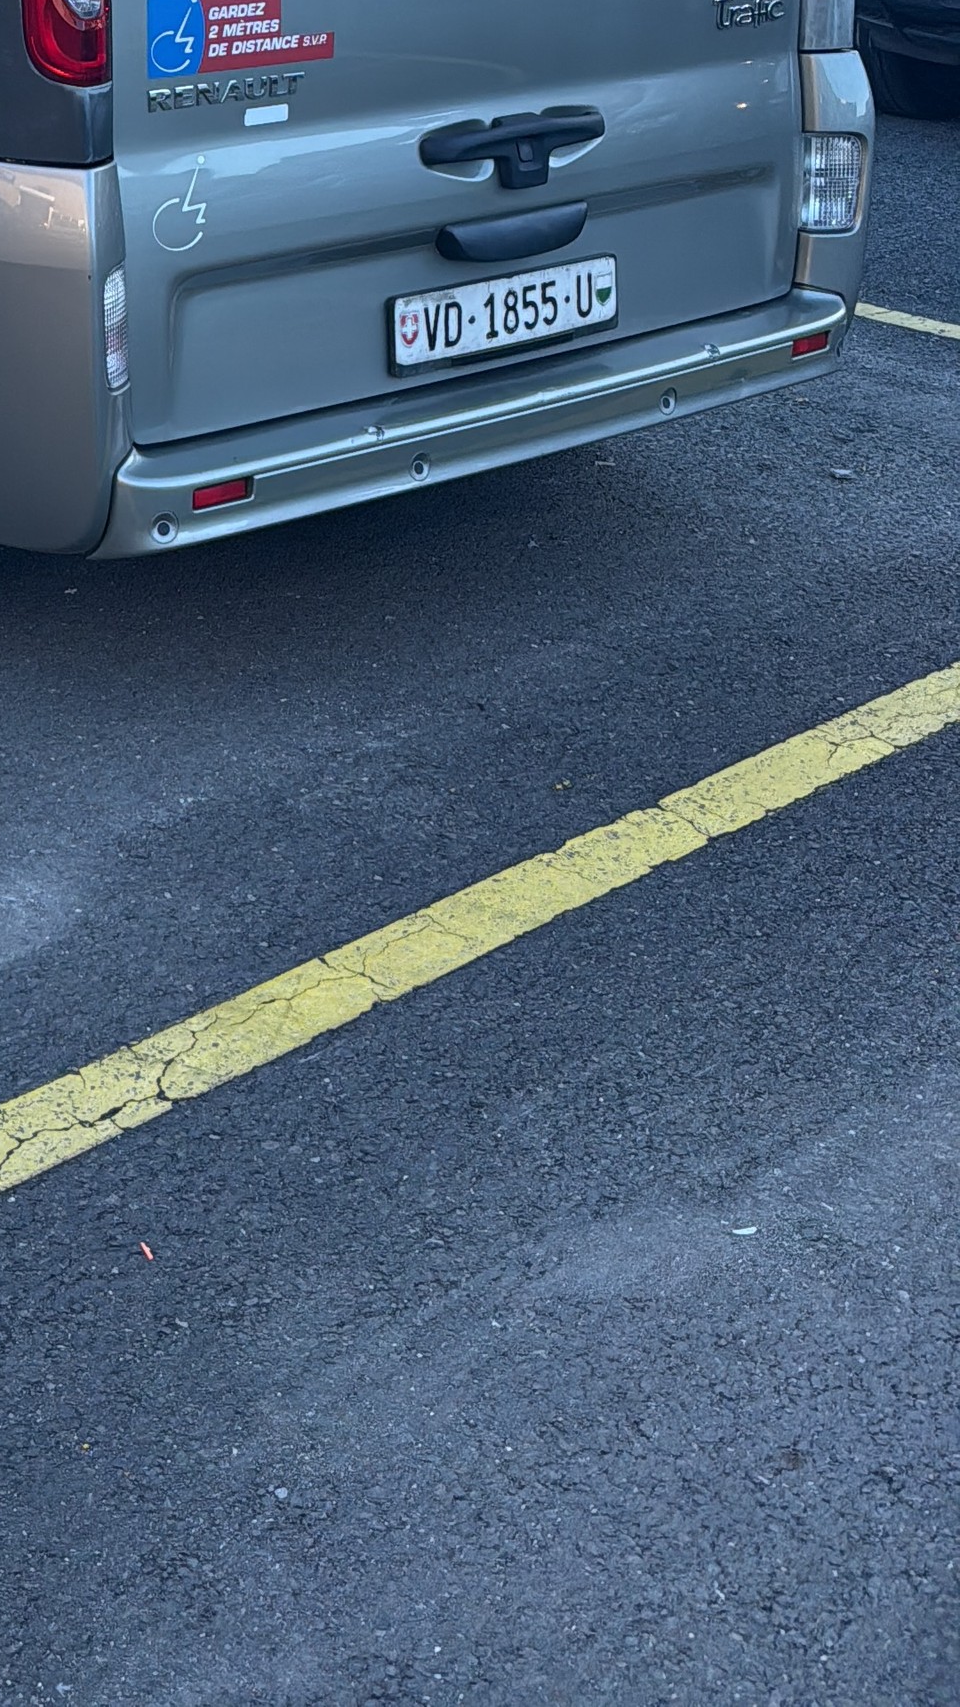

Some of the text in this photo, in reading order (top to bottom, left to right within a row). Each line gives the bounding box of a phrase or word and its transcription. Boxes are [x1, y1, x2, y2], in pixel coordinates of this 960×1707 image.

[208, 2, 266, 21] GARDEZ
[208, 19, 280, 39] 2 MÈTRES
[208, 43, 228, 58] DE
[231, 35, 300, 55] DISTANCE
[147, 71, 305, 113] RENAULT
